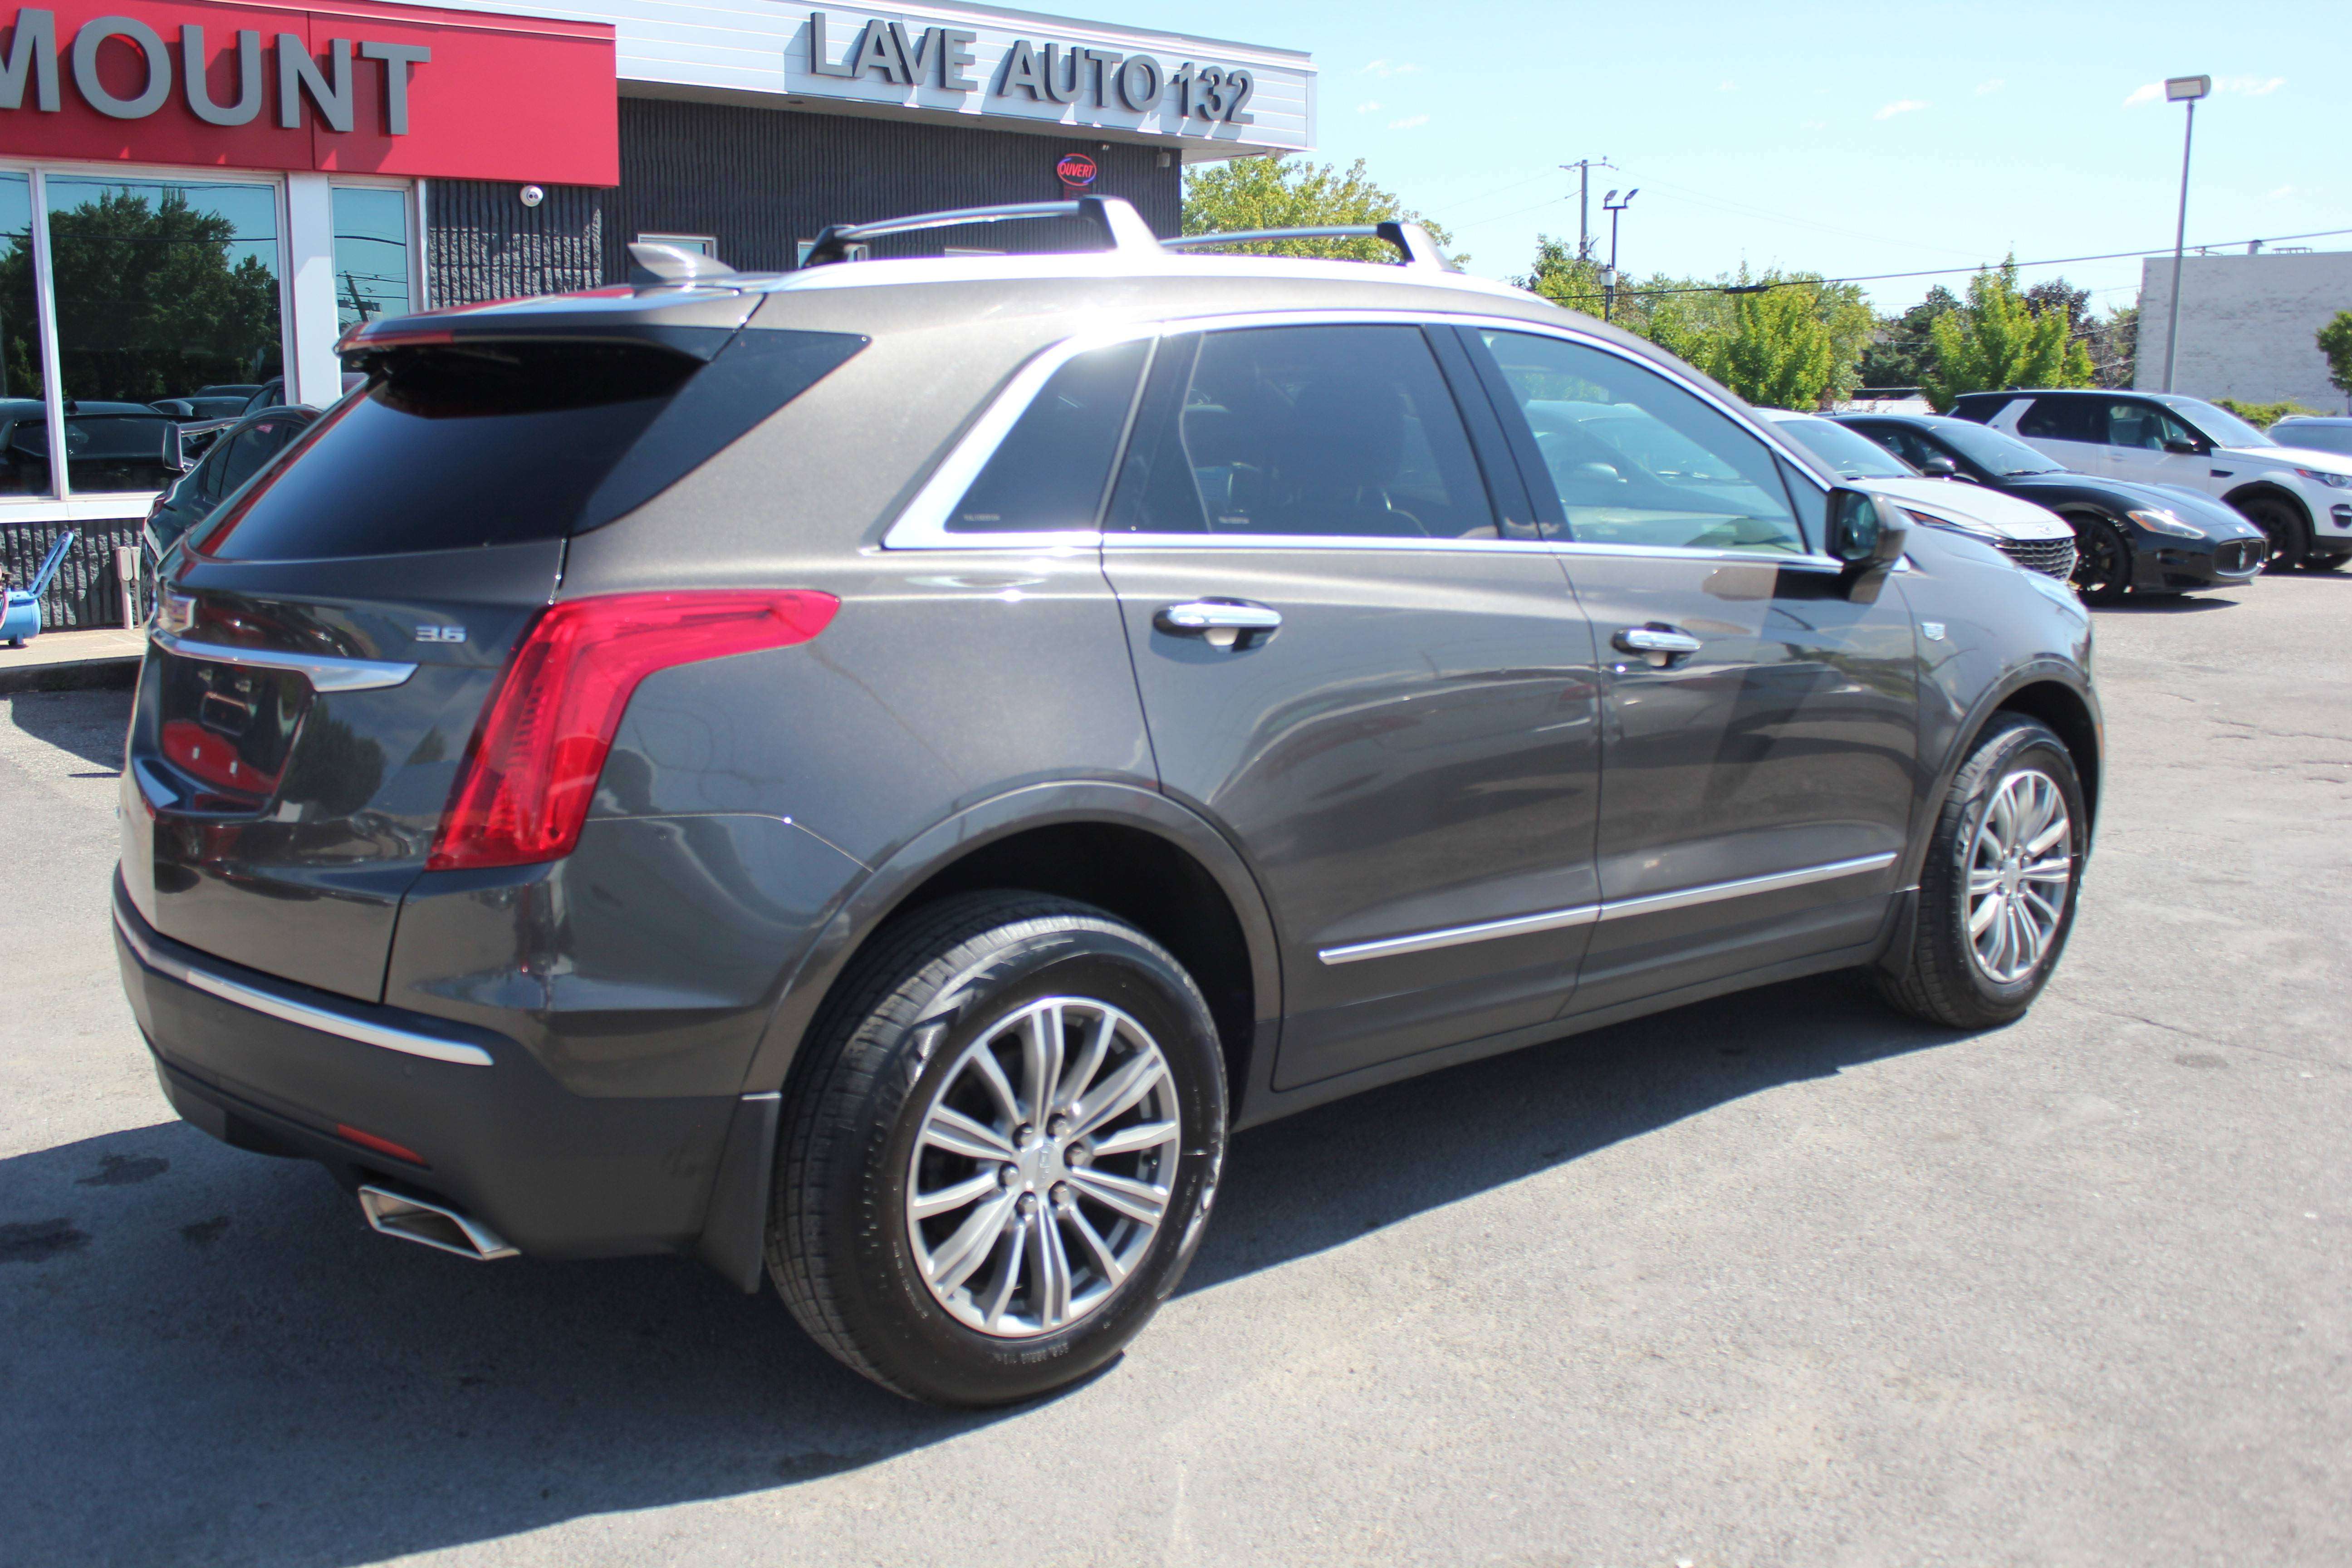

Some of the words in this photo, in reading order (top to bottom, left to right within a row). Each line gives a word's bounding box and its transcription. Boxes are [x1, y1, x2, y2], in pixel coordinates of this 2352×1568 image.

[810, 12, 978, 91] LAVE
[1001, 39, 1164, 113] AUTO
[1173, 62, 1255, 125] 132
[1059, 162, 1093, 177] OUVERT
